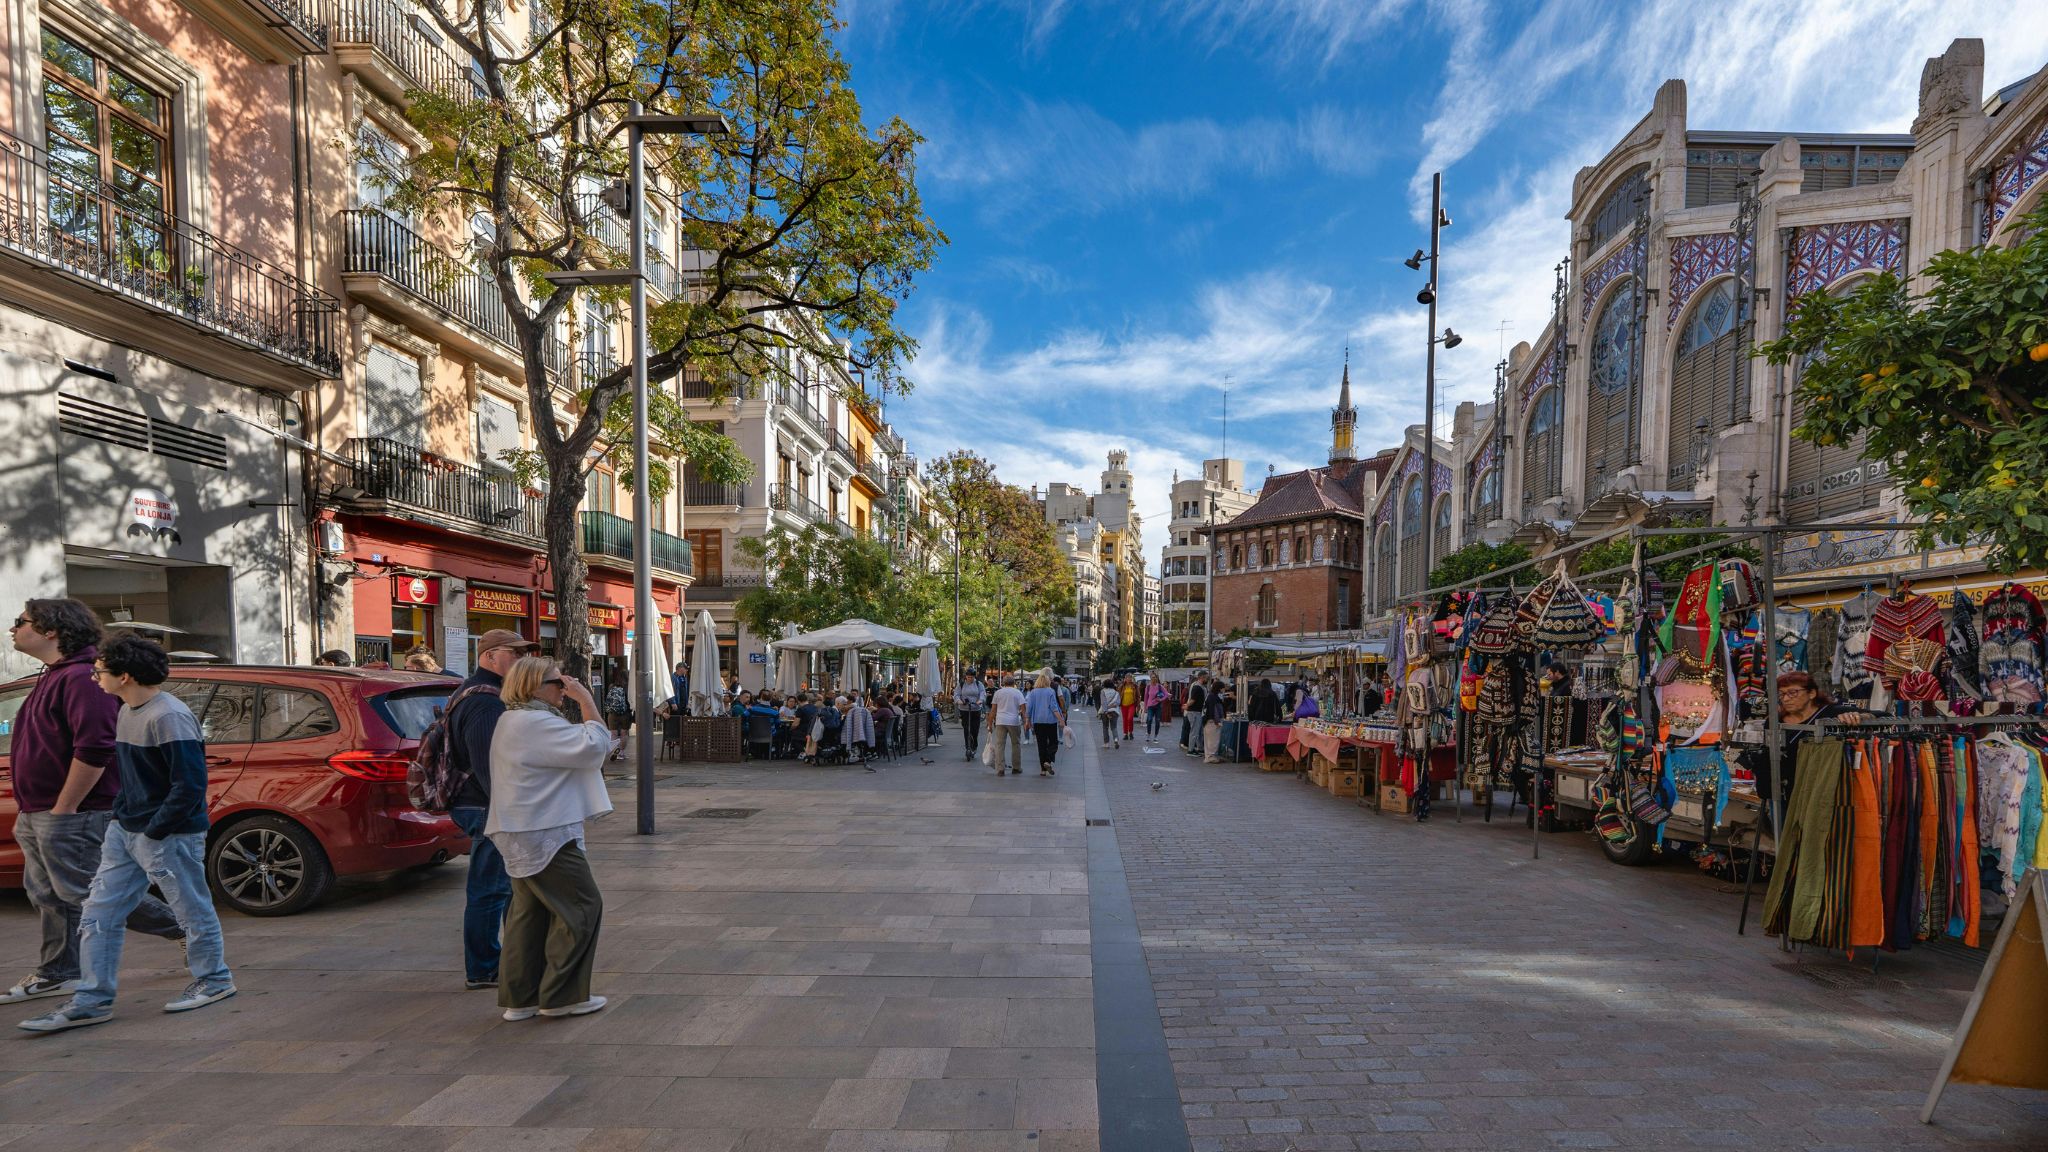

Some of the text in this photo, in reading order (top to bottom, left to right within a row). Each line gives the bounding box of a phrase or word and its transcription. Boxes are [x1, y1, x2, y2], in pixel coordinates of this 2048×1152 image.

[134, 497, 171, 510] SOUVENIRS
[135, 507, 172, 521] LA LONJA
[898, 478, 906, 550] FARMACIA
[474, 589, 520, 603] CALAMARES
[1937, 590, 1982, 605] PAEAS
[474, 600, 522, 612] PESCADITOS
[588, 606, 615, 619] ATELLA
